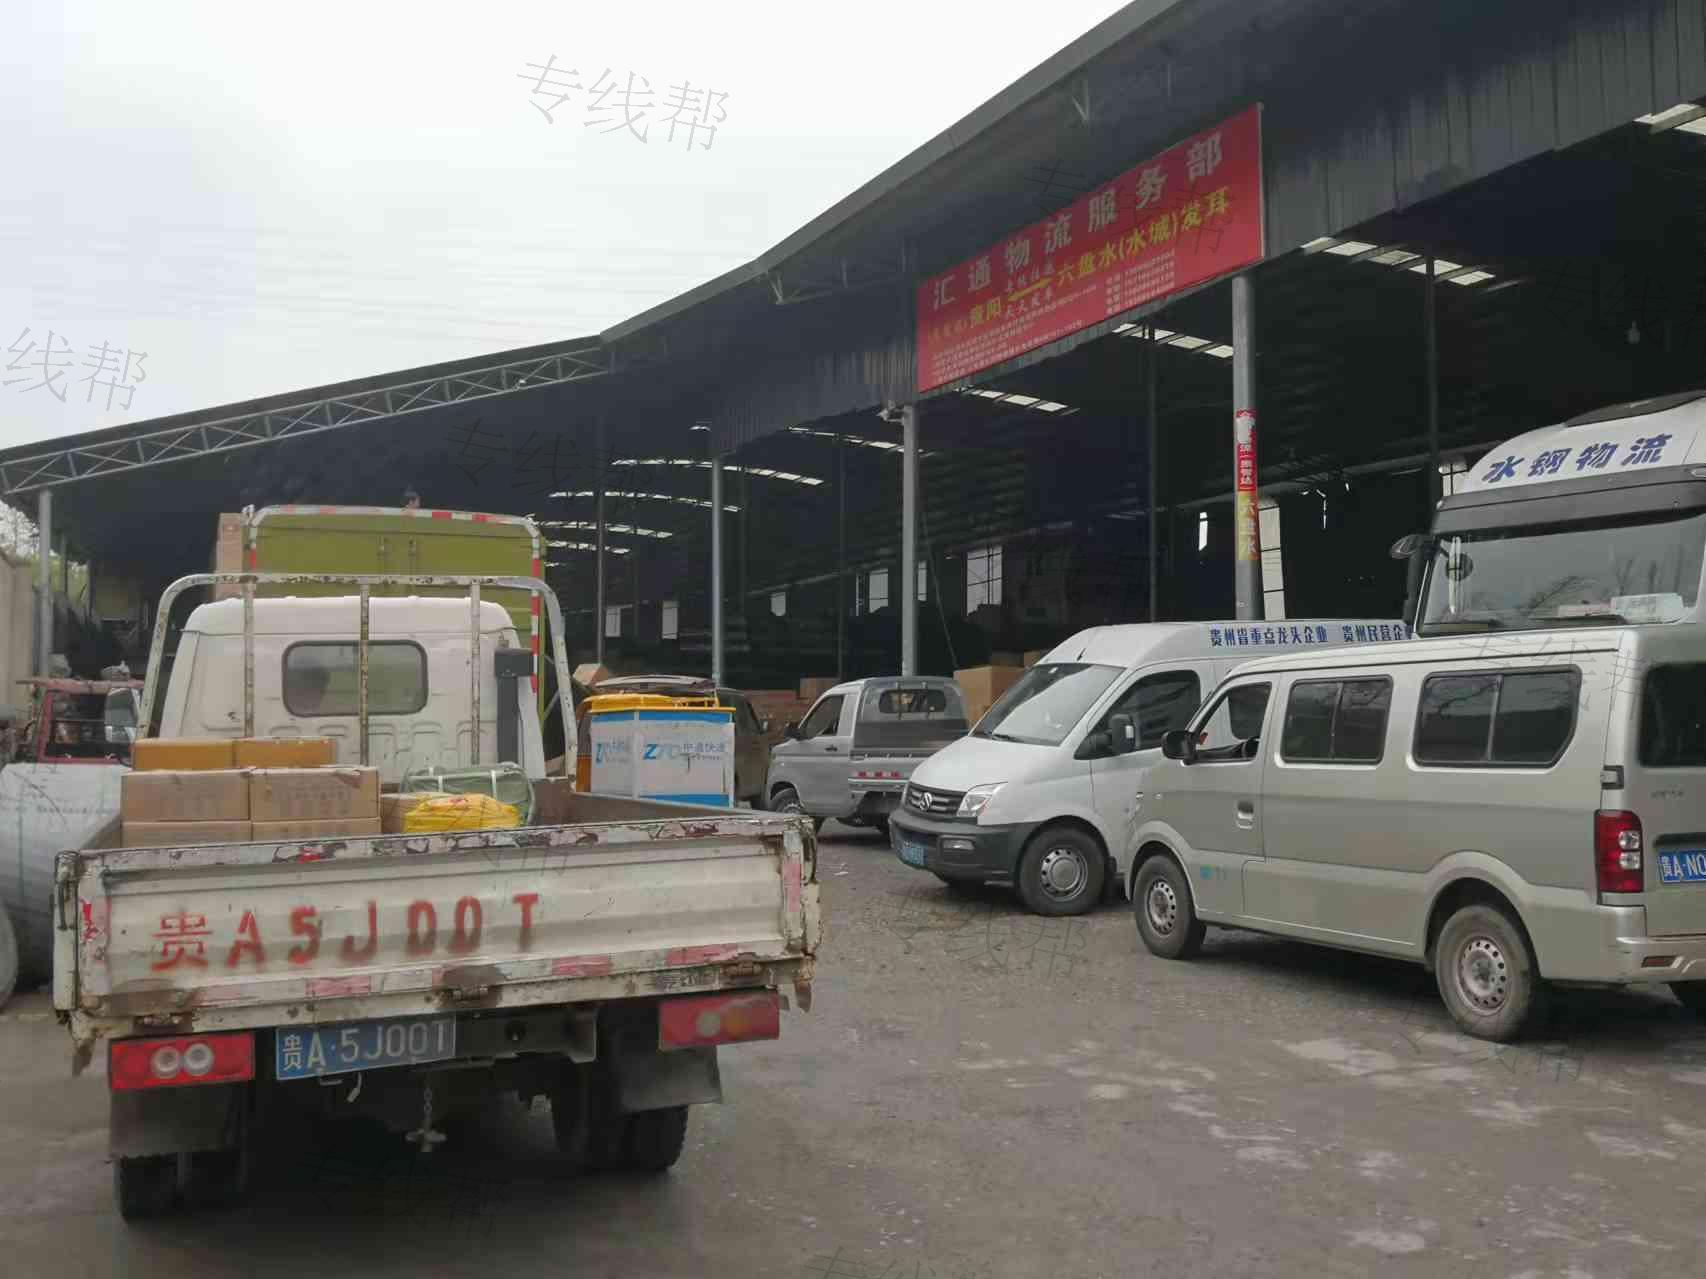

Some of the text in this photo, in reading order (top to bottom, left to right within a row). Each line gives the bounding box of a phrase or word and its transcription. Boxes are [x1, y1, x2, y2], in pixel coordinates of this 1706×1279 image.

[932, 131, 1223, 310] 汇通物流服务部
[1482, 433, 1673, 484] 水钢物流
[1210, 624, 1328, 647] 贵州省重点龙头企业
